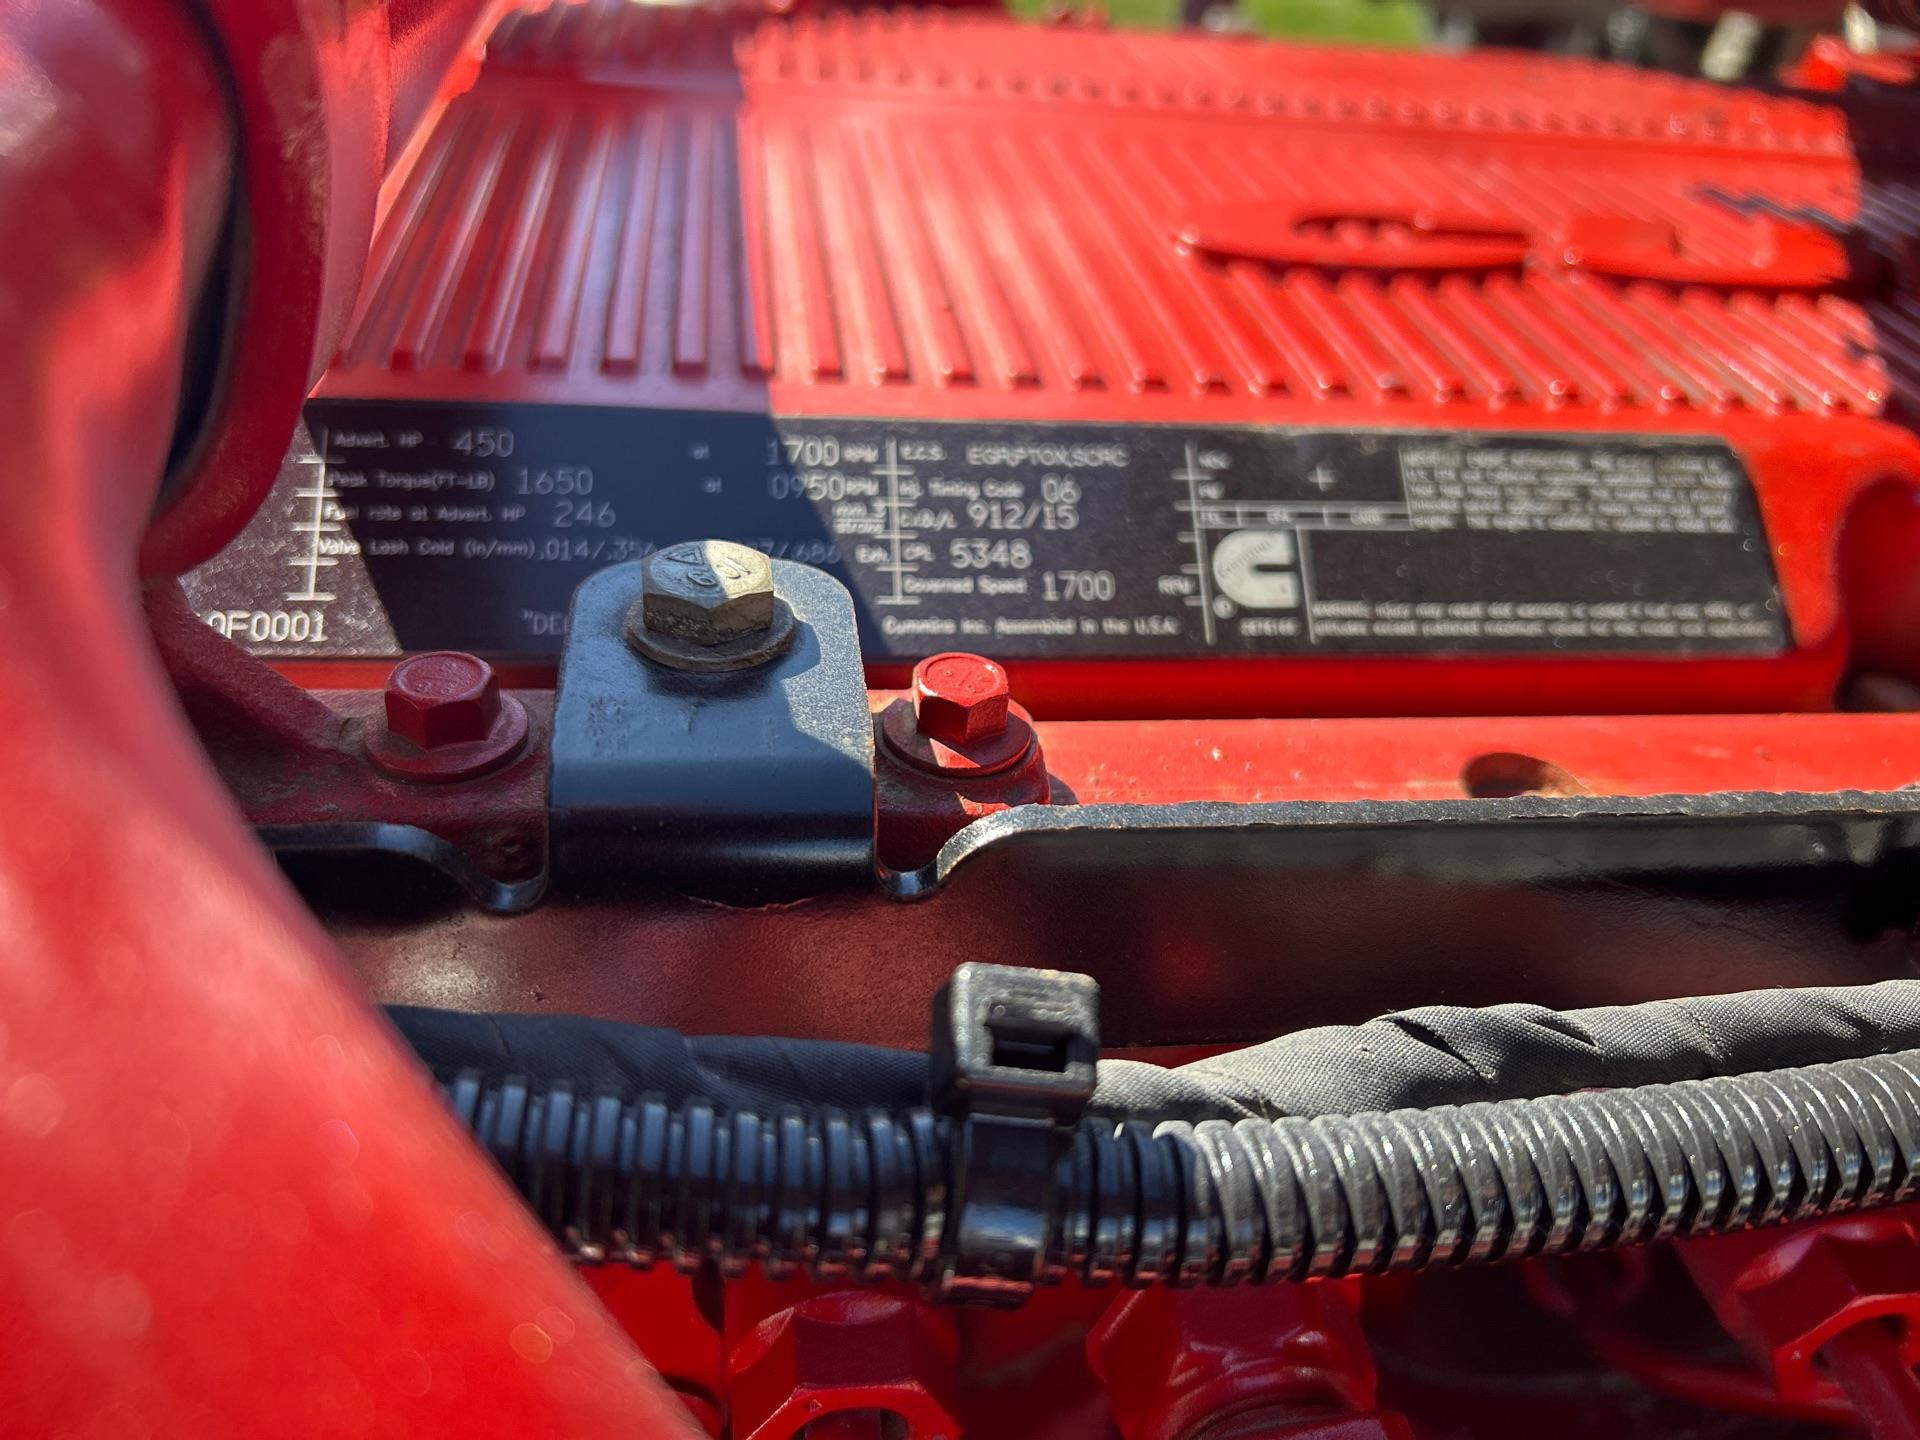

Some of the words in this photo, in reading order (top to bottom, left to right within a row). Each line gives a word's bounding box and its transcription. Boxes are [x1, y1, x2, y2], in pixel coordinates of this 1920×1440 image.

[452, 428, 514, 457] 450
[766, 434, 840, 467] 1700
[517, 466, 593, 495] 1650
[768, 469, 846, 500] 0950
[1041, 473, 1082, 503] 06
[501, 503, 526, 521] HP
[554, 498, 616, 527] 246
[966, 499, 1080, 530] 912/15
[317, 536, 361, 555] Valve
[415, 536, 455, 556] Cold
[950, 538, 1033, 568] 5348
[977, 574, 1027, 596] Speed
[1042, 570, 1116, 601] 1700
